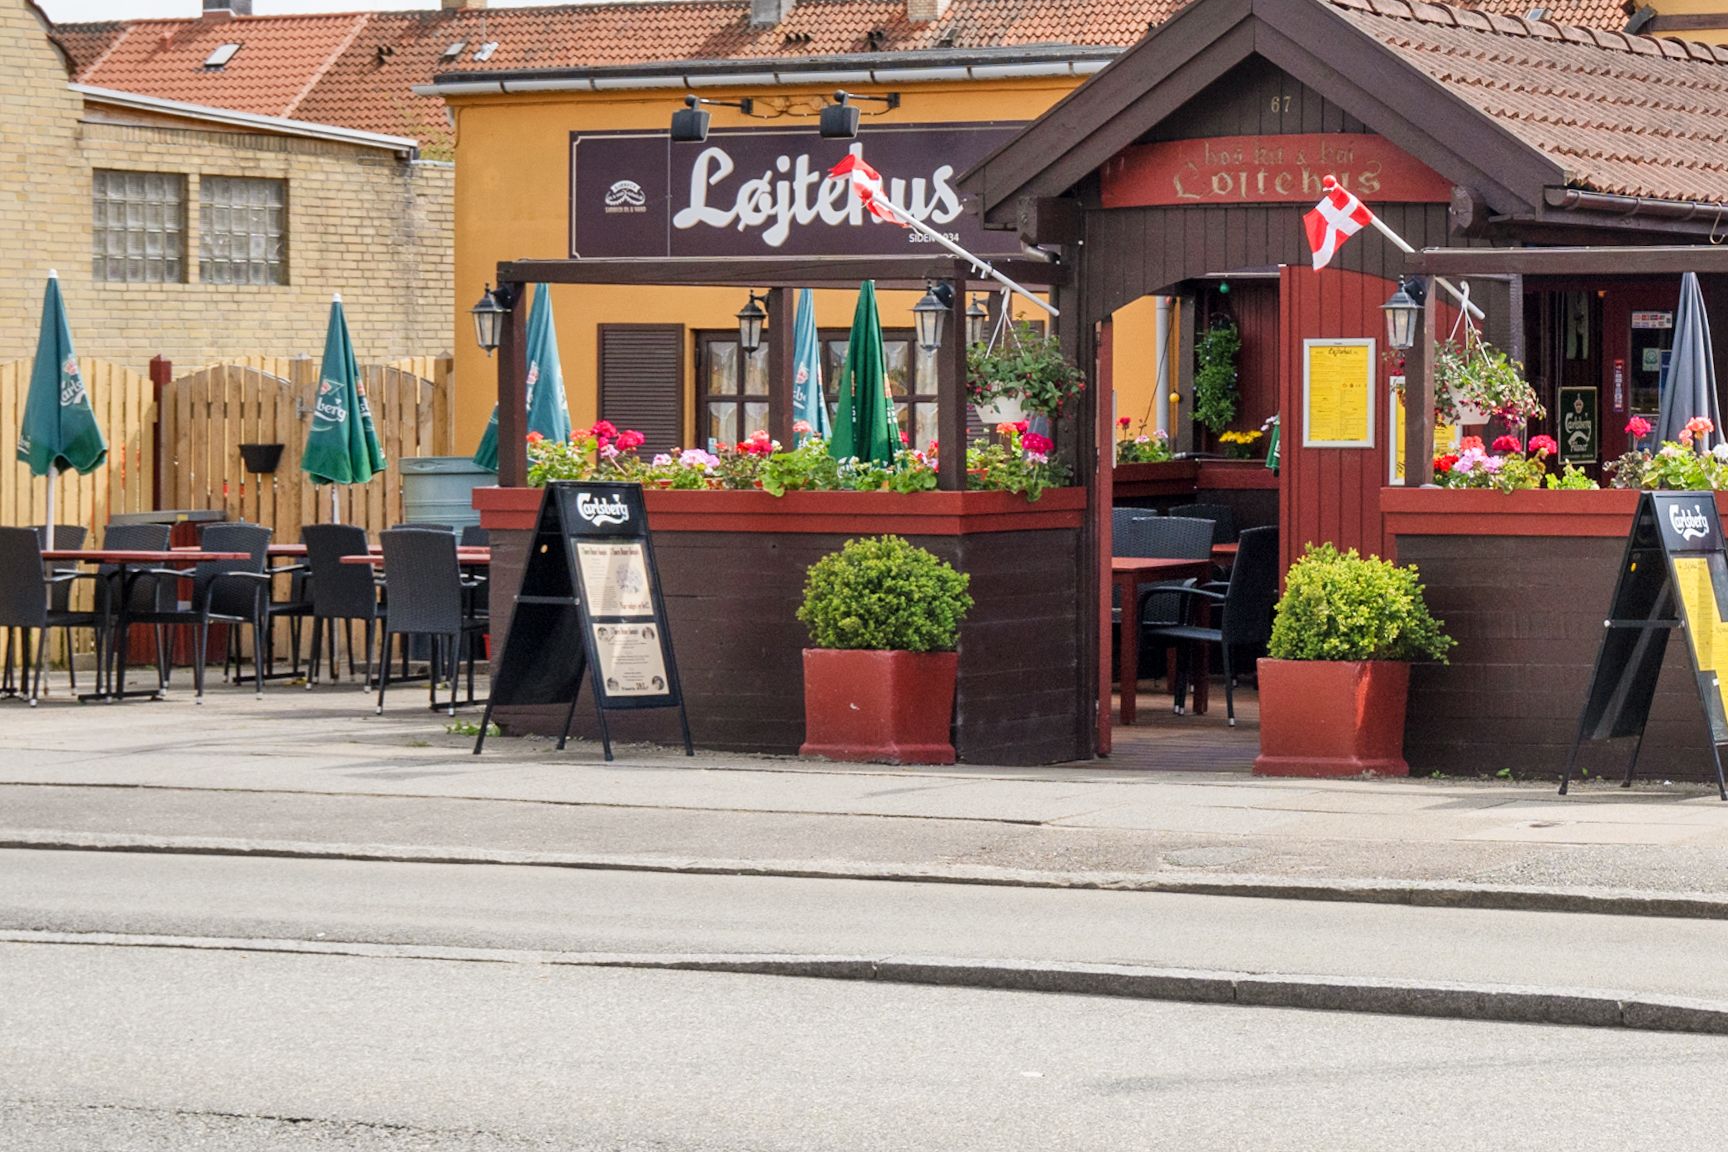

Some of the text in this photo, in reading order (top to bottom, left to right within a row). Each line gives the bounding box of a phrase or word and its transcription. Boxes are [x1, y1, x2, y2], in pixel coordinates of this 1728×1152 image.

[1271, 96, 1291, 113] 67
[673, 142, 964, 247] Løjtehus
[939, 233, 960, 242] 934
[576, 492, 630, 526] Carlsberg
[1669, 504, 1710, 541] Carlsberg
